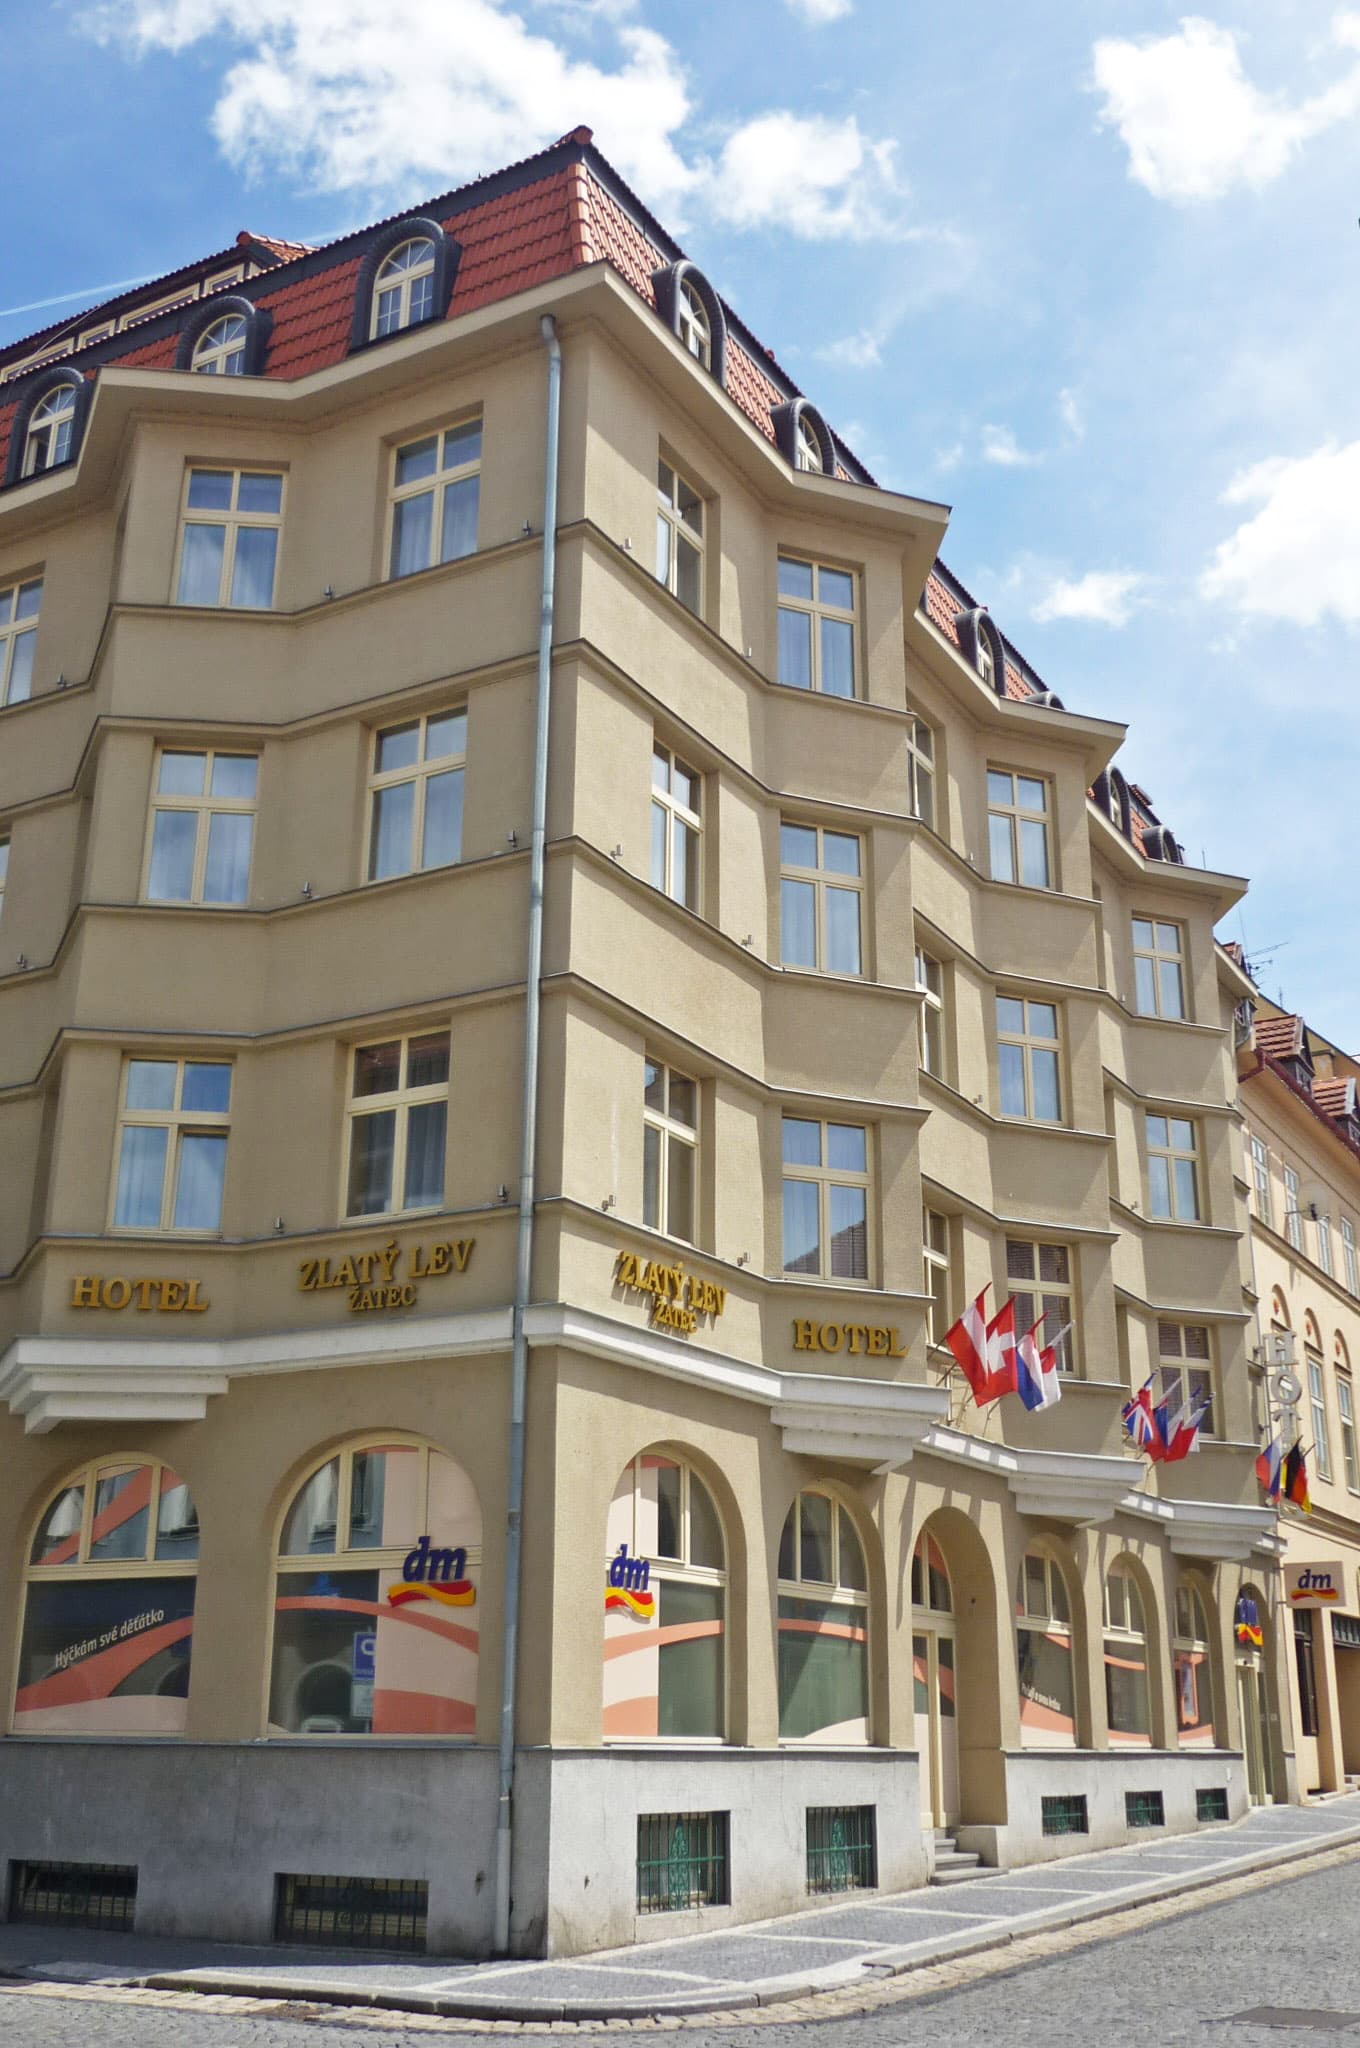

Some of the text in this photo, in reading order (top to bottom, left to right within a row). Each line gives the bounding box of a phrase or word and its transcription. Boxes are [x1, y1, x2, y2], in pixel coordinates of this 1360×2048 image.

[298, 1238, 475, 1291] ZLATÝ LEV
[617, 1249, 728, 1316] ZLATÝ LEV
[71, 1276, 209, 1312] HOTEL
[348, 1283, 417, 1313] ŽATEC
[653, 1297, 698, 1334] ŽATEC
[793, 1318, 909, 1358] HOTEL
[402, 1536, 467, 1582] dm
[609, 1544, 651, 1592] dm
[1298, 1568, 1332, 1589] dm
[54, 1638, 98, 1669] Hýčkám
[99, 1625, 118, 1647] své
